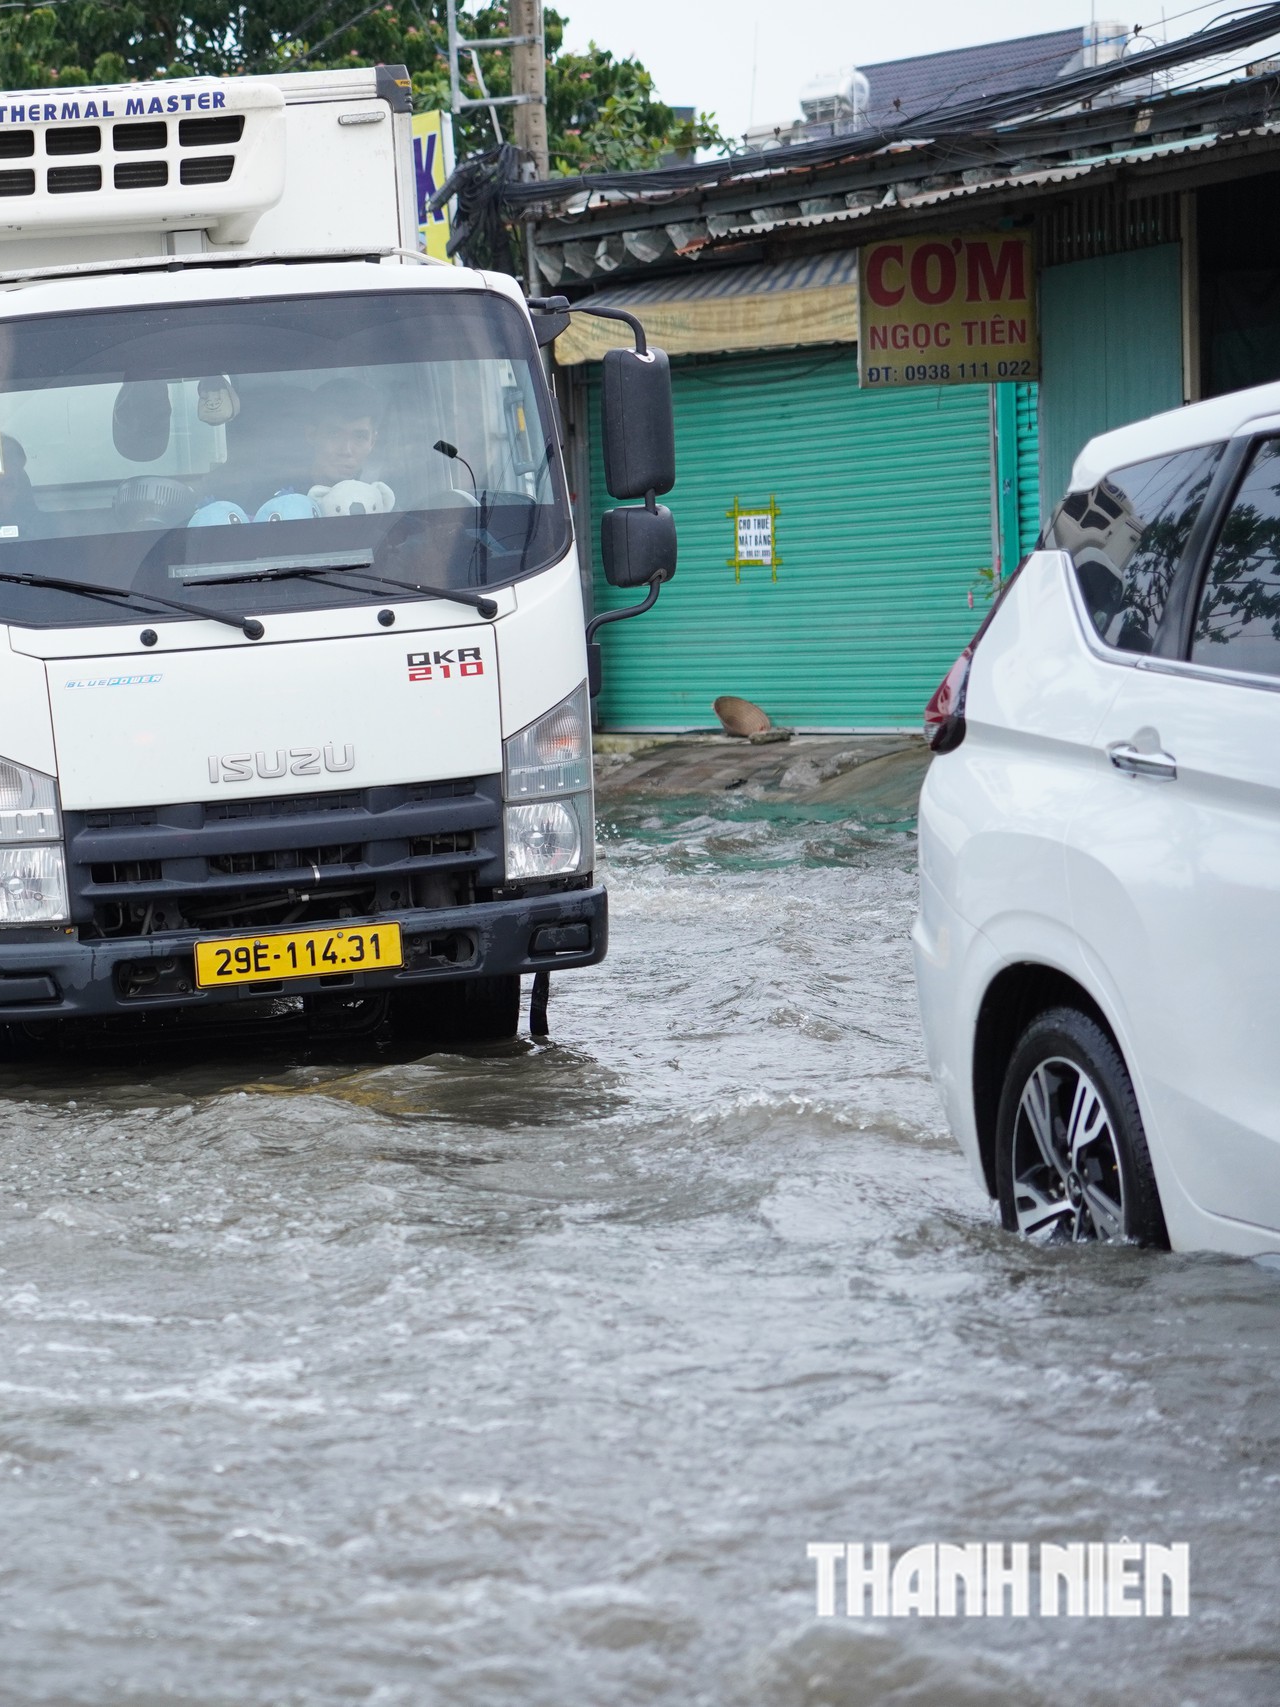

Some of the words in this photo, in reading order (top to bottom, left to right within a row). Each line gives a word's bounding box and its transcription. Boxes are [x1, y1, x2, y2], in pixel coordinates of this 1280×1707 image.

[125, 91, 227, 116] MASTER
[866, 237, 1027, 308] CƠM
[870, 321, 951, 354] NGỌC
[961, 314, 1027, 346] TIÊN
[868, 366, 898, 383] ĐT:
[905, 364, 950, 381] 0938
[958, 362, 989, 379] 111
[997, 360, 1031, 377] 022
[407, 647, 482, 667] QKR
[408, 661, 484, 682] 210
[208, 743, 356, 784] ISUZU
[214, 933, 381, 977] 29E-114.31
